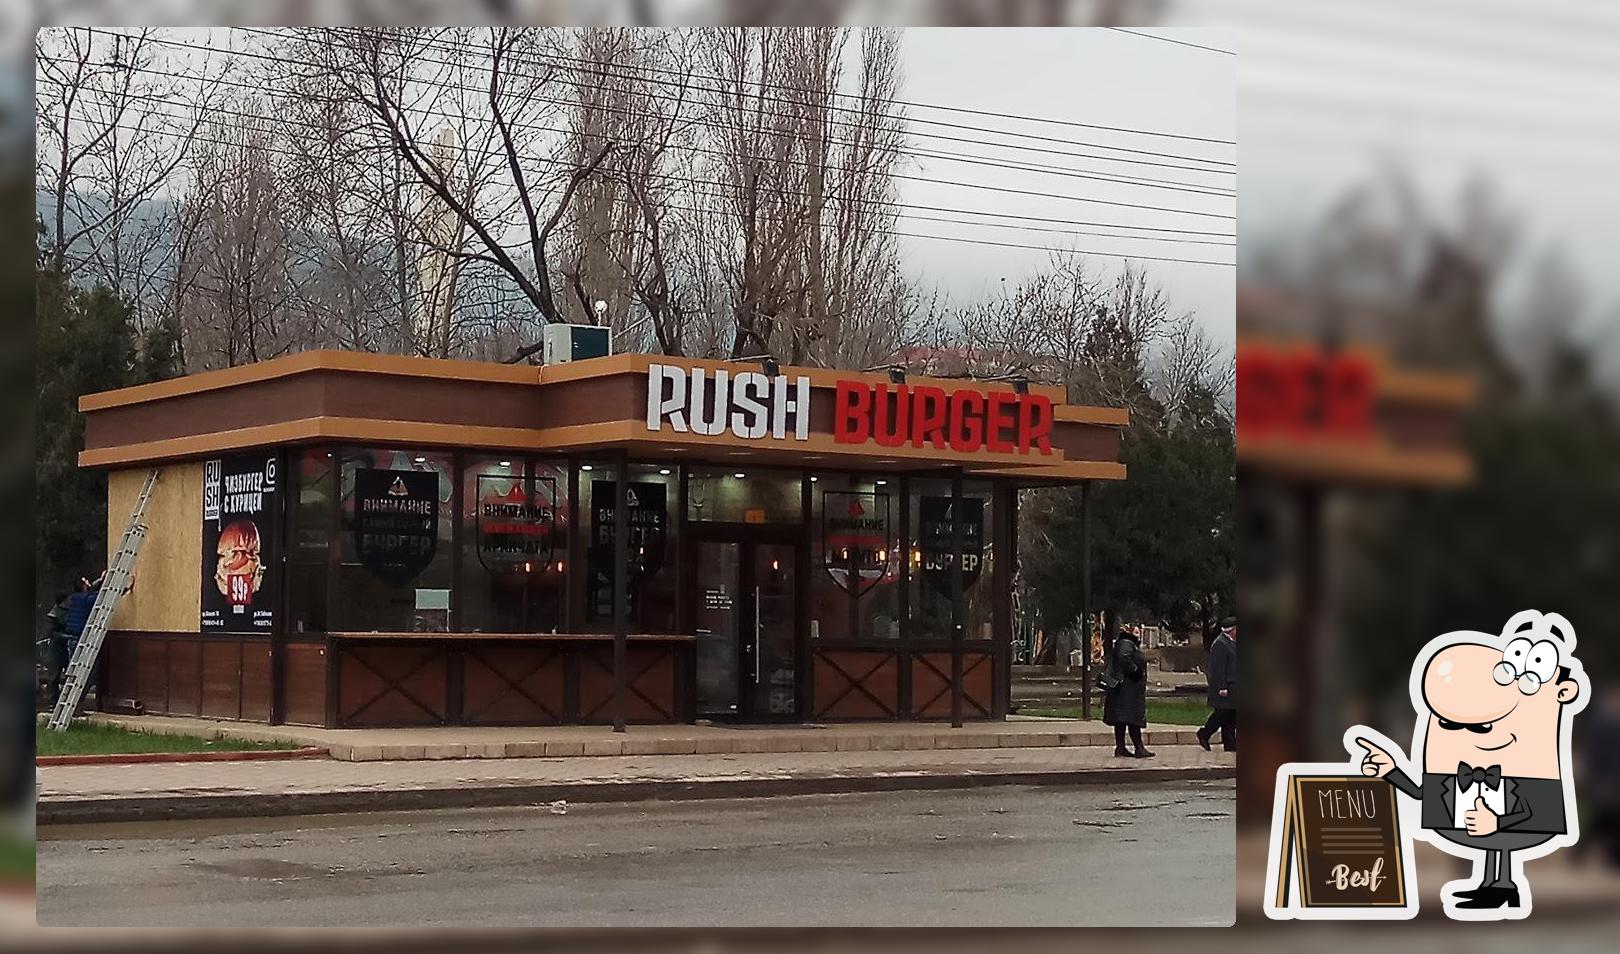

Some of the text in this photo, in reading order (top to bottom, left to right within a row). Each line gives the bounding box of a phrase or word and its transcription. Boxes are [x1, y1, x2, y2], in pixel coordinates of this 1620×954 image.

[646, 363, 1053, 456] RUSH BURGER
[363, 499, 432, 514] ВНИМАНИЕ
[925, 553, 978, 571] БУРЕР
